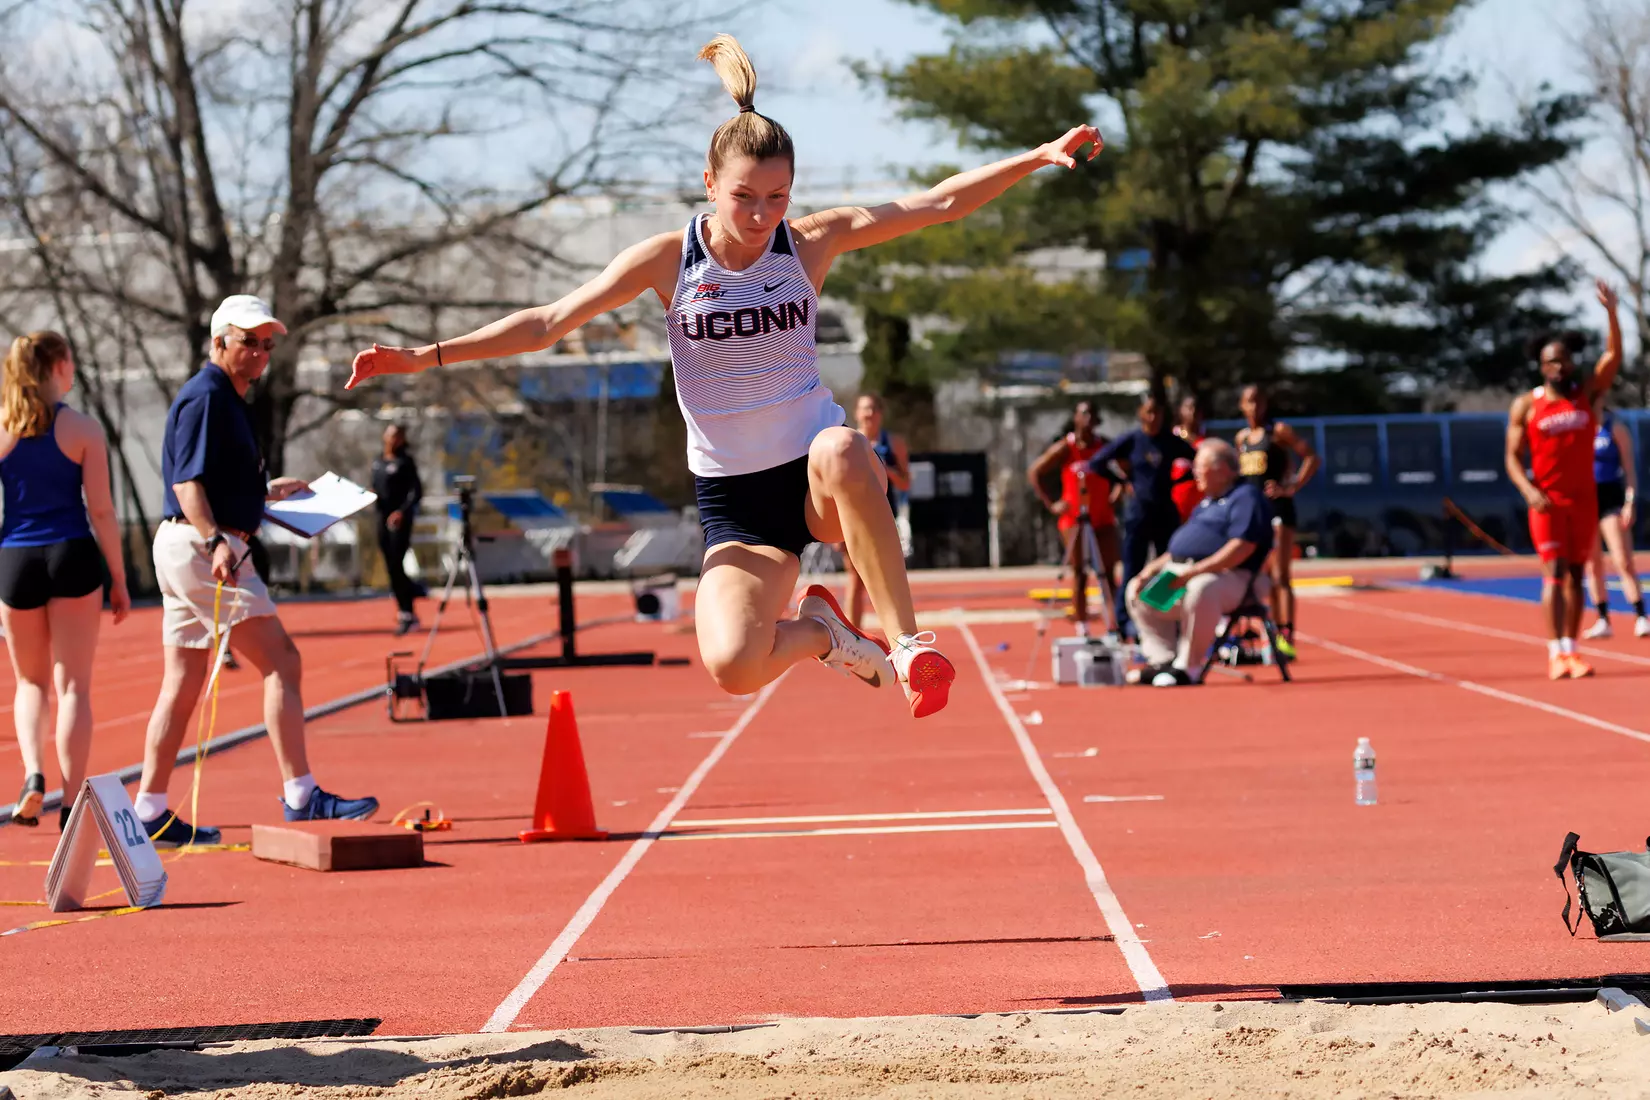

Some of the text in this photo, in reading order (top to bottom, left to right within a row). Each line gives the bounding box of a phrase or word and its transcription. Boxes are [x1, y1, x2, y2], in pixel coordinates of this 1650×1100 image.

[693, 290, 728, 299] EAST
[697, 283, 721, 292] BIG
[681, 298, 809, 341] UCONN
[114, 808, 146, 847] 22
